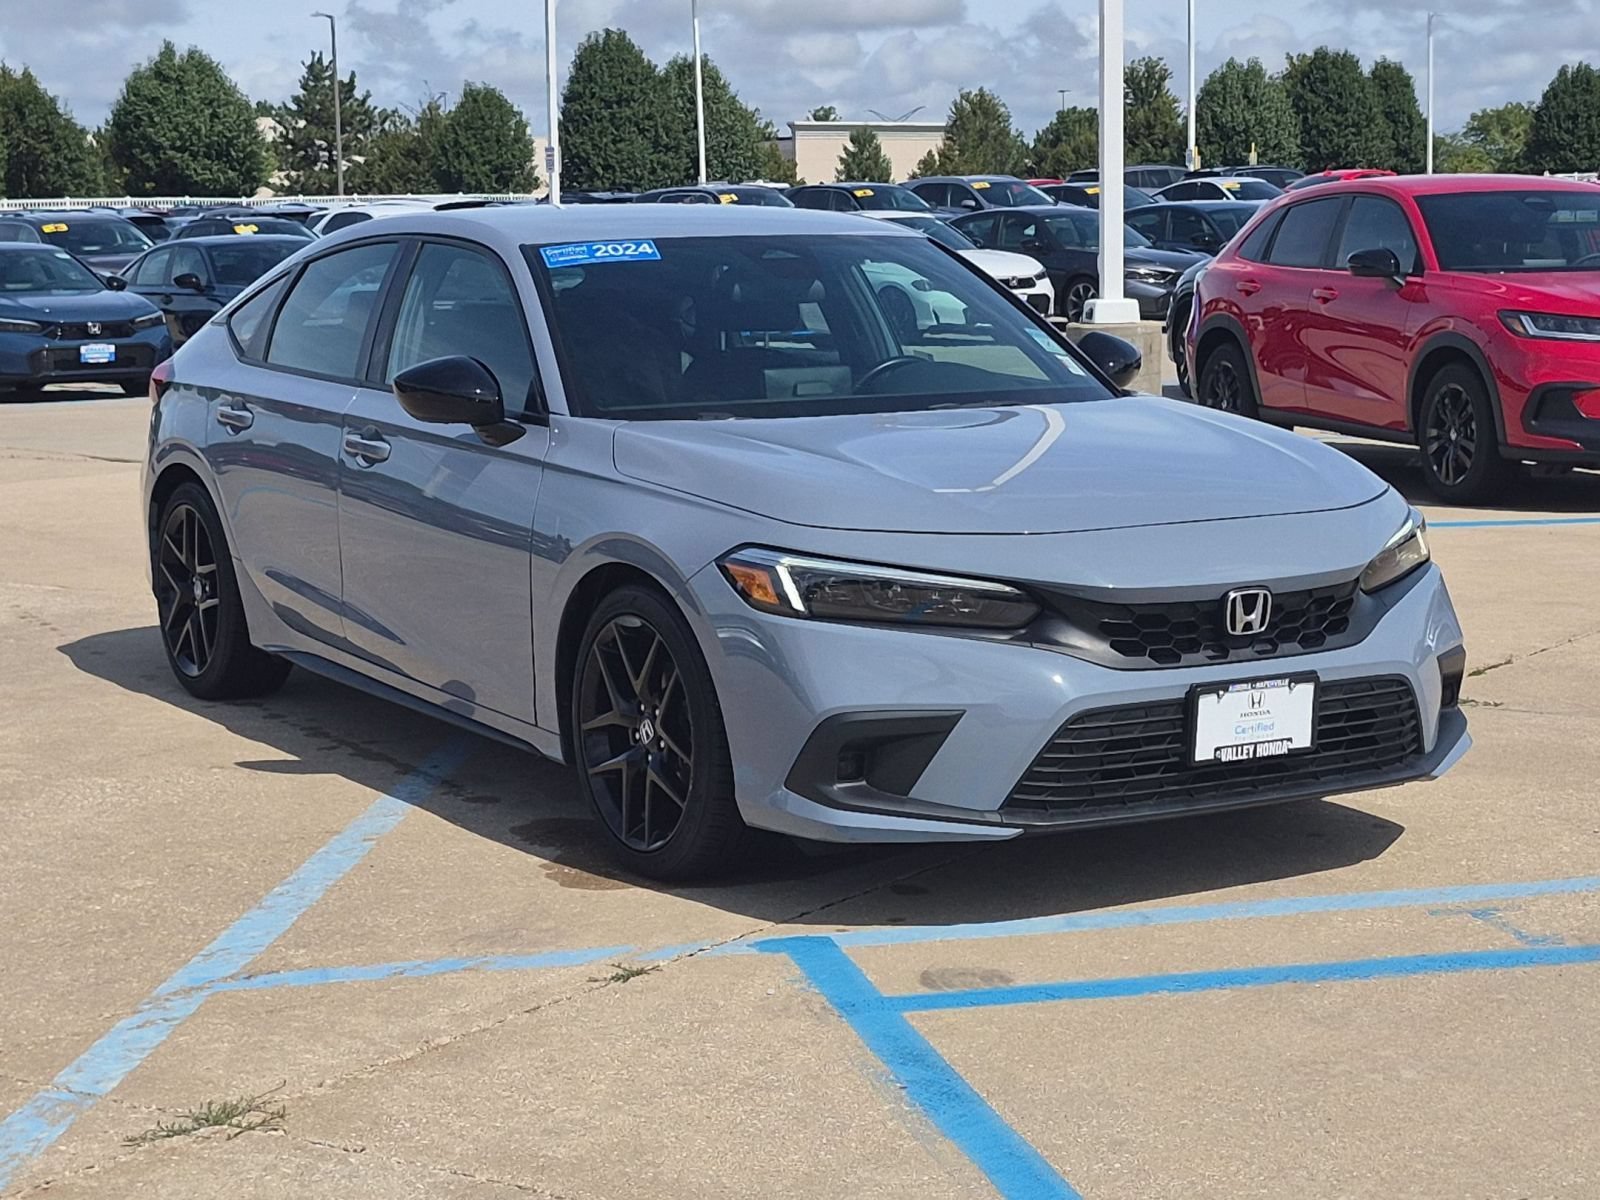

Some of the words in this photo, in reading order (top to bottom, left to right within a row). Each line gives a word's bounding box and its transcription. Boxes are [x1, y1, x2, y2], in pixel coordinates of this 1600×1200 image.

[592, 243, 653, 257] 2024
[1240, 709, 1271, 718] HONDA
[1234, 722, 1275, 735] Certified
[1221, 744, 1255, 762] VALLEY
[1256, 740, 1289, 758] HONDA
